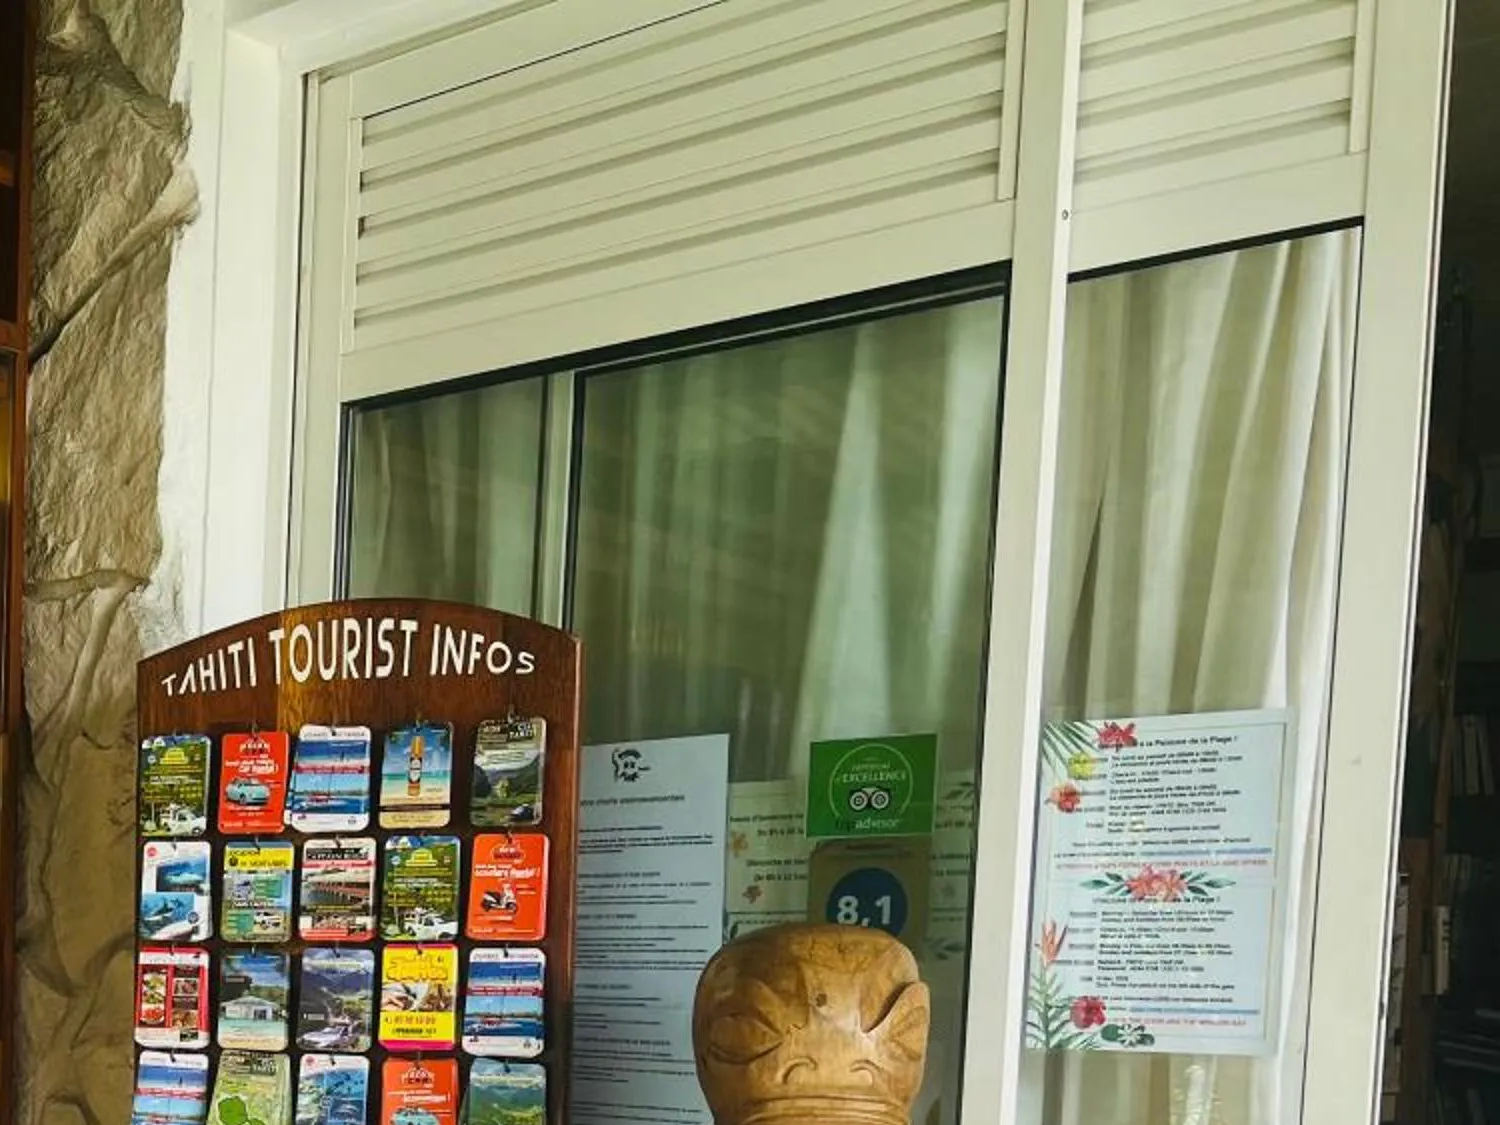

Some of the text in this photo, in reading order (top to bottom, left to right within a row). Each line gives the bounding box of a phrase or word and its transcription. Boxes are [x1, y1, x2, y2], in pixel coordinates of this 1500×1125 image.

[161, 637, 257, 697] TAHITI
[269, 617, 419, 685] TOURIST
[836, 894, 893, 928] 8,1
